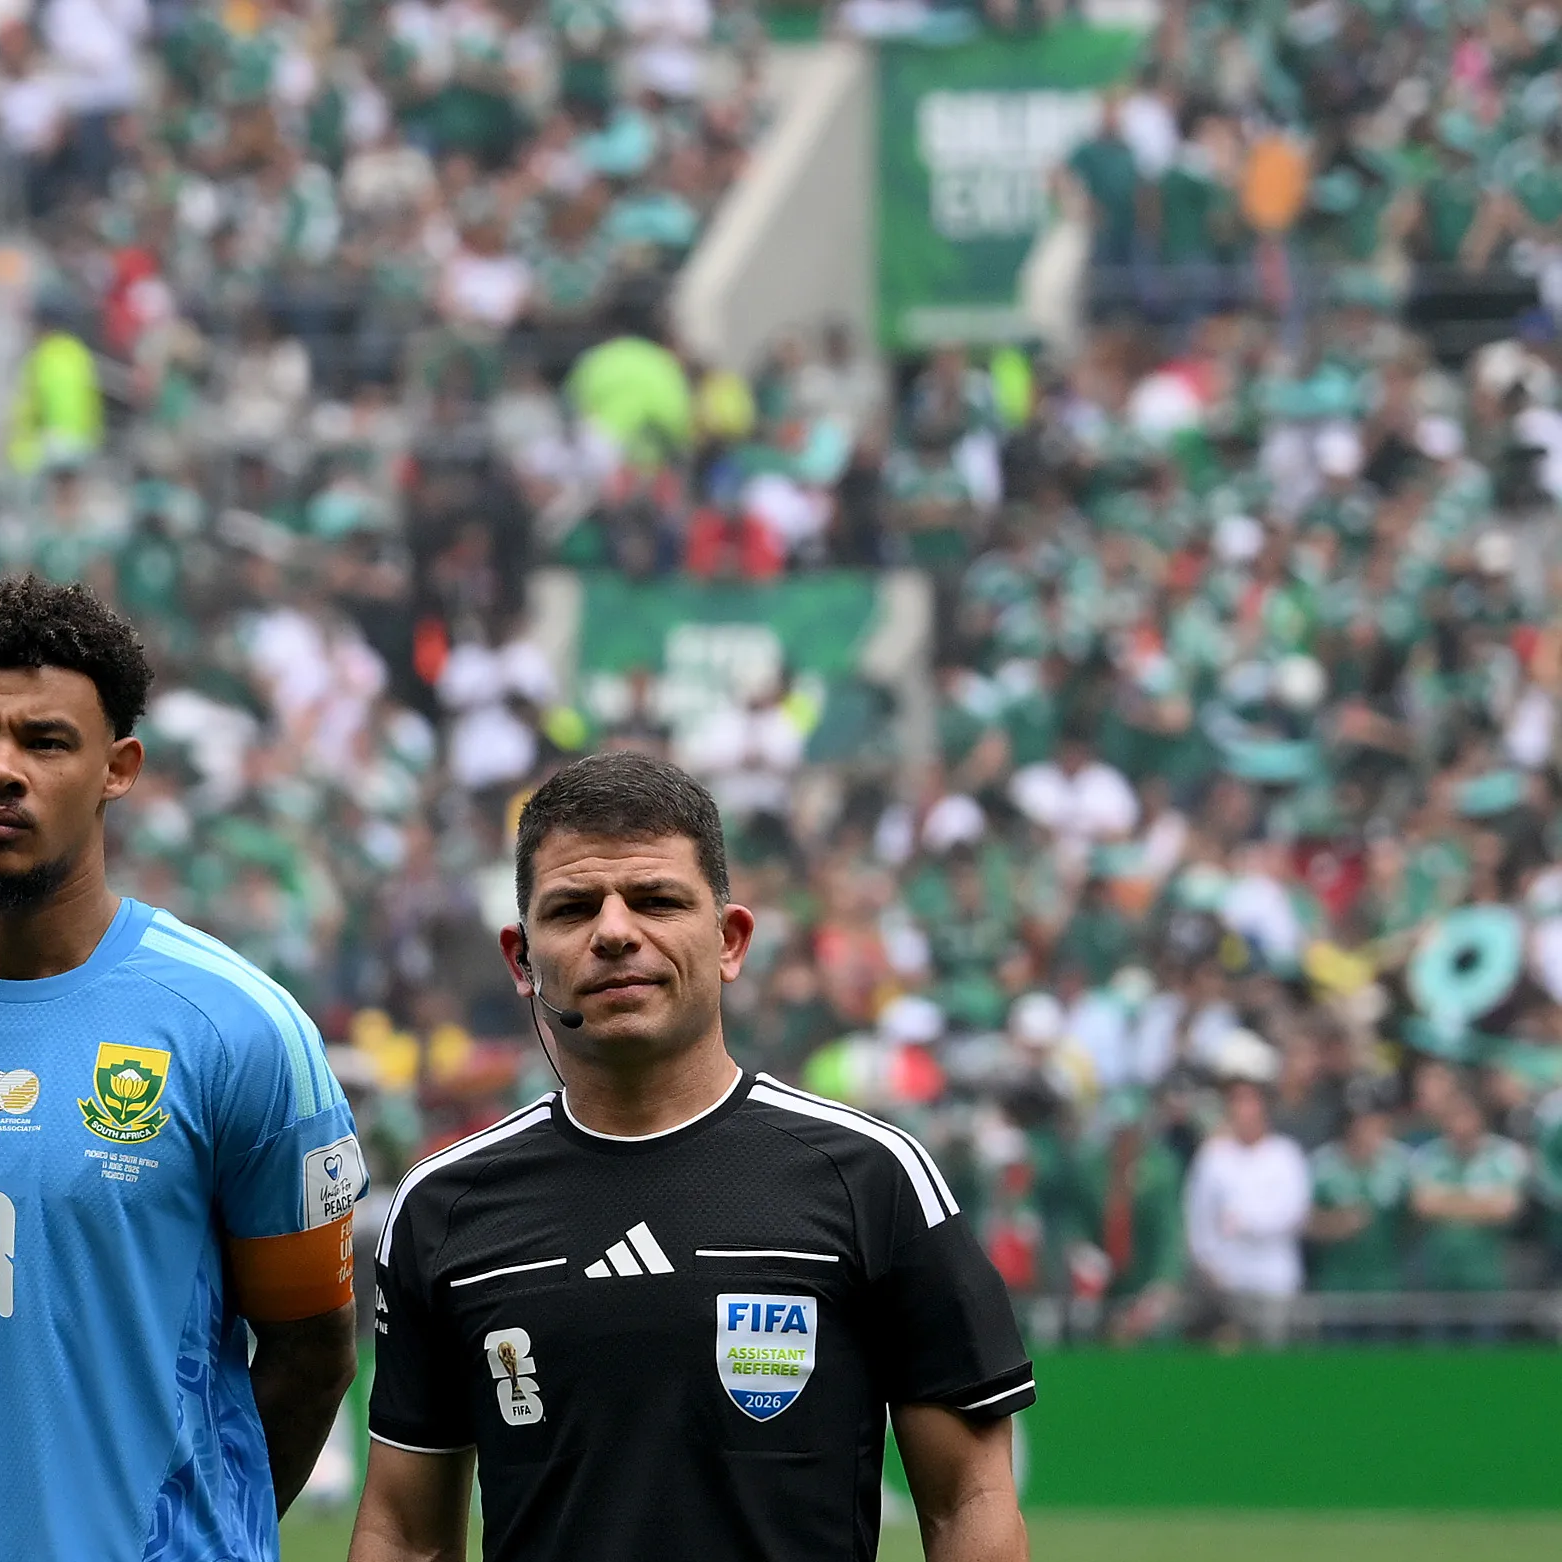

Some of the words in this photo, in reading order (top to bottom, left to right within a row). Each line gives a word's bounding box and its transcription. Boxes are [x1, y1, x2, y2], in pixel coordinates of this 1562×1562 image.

[91, 1120, 118, 1138] SOUTH
[119, 1128, 152, 1140] AFRICA
[118, 1154, 138, 1164] SOUTH
[138, 1158, 159, 1169] AFRICA
[324, 1194, 353, 1217] PEACE
[727, 1302, 808, 1335] FIFA
[726, 1346, 807, 1361] ASSISTANT
[731, 1361, 800, 1377] REFEREE
[744, 1394, 782, 1409] 2026
[511, 1404, 532, 1416] FIFA
